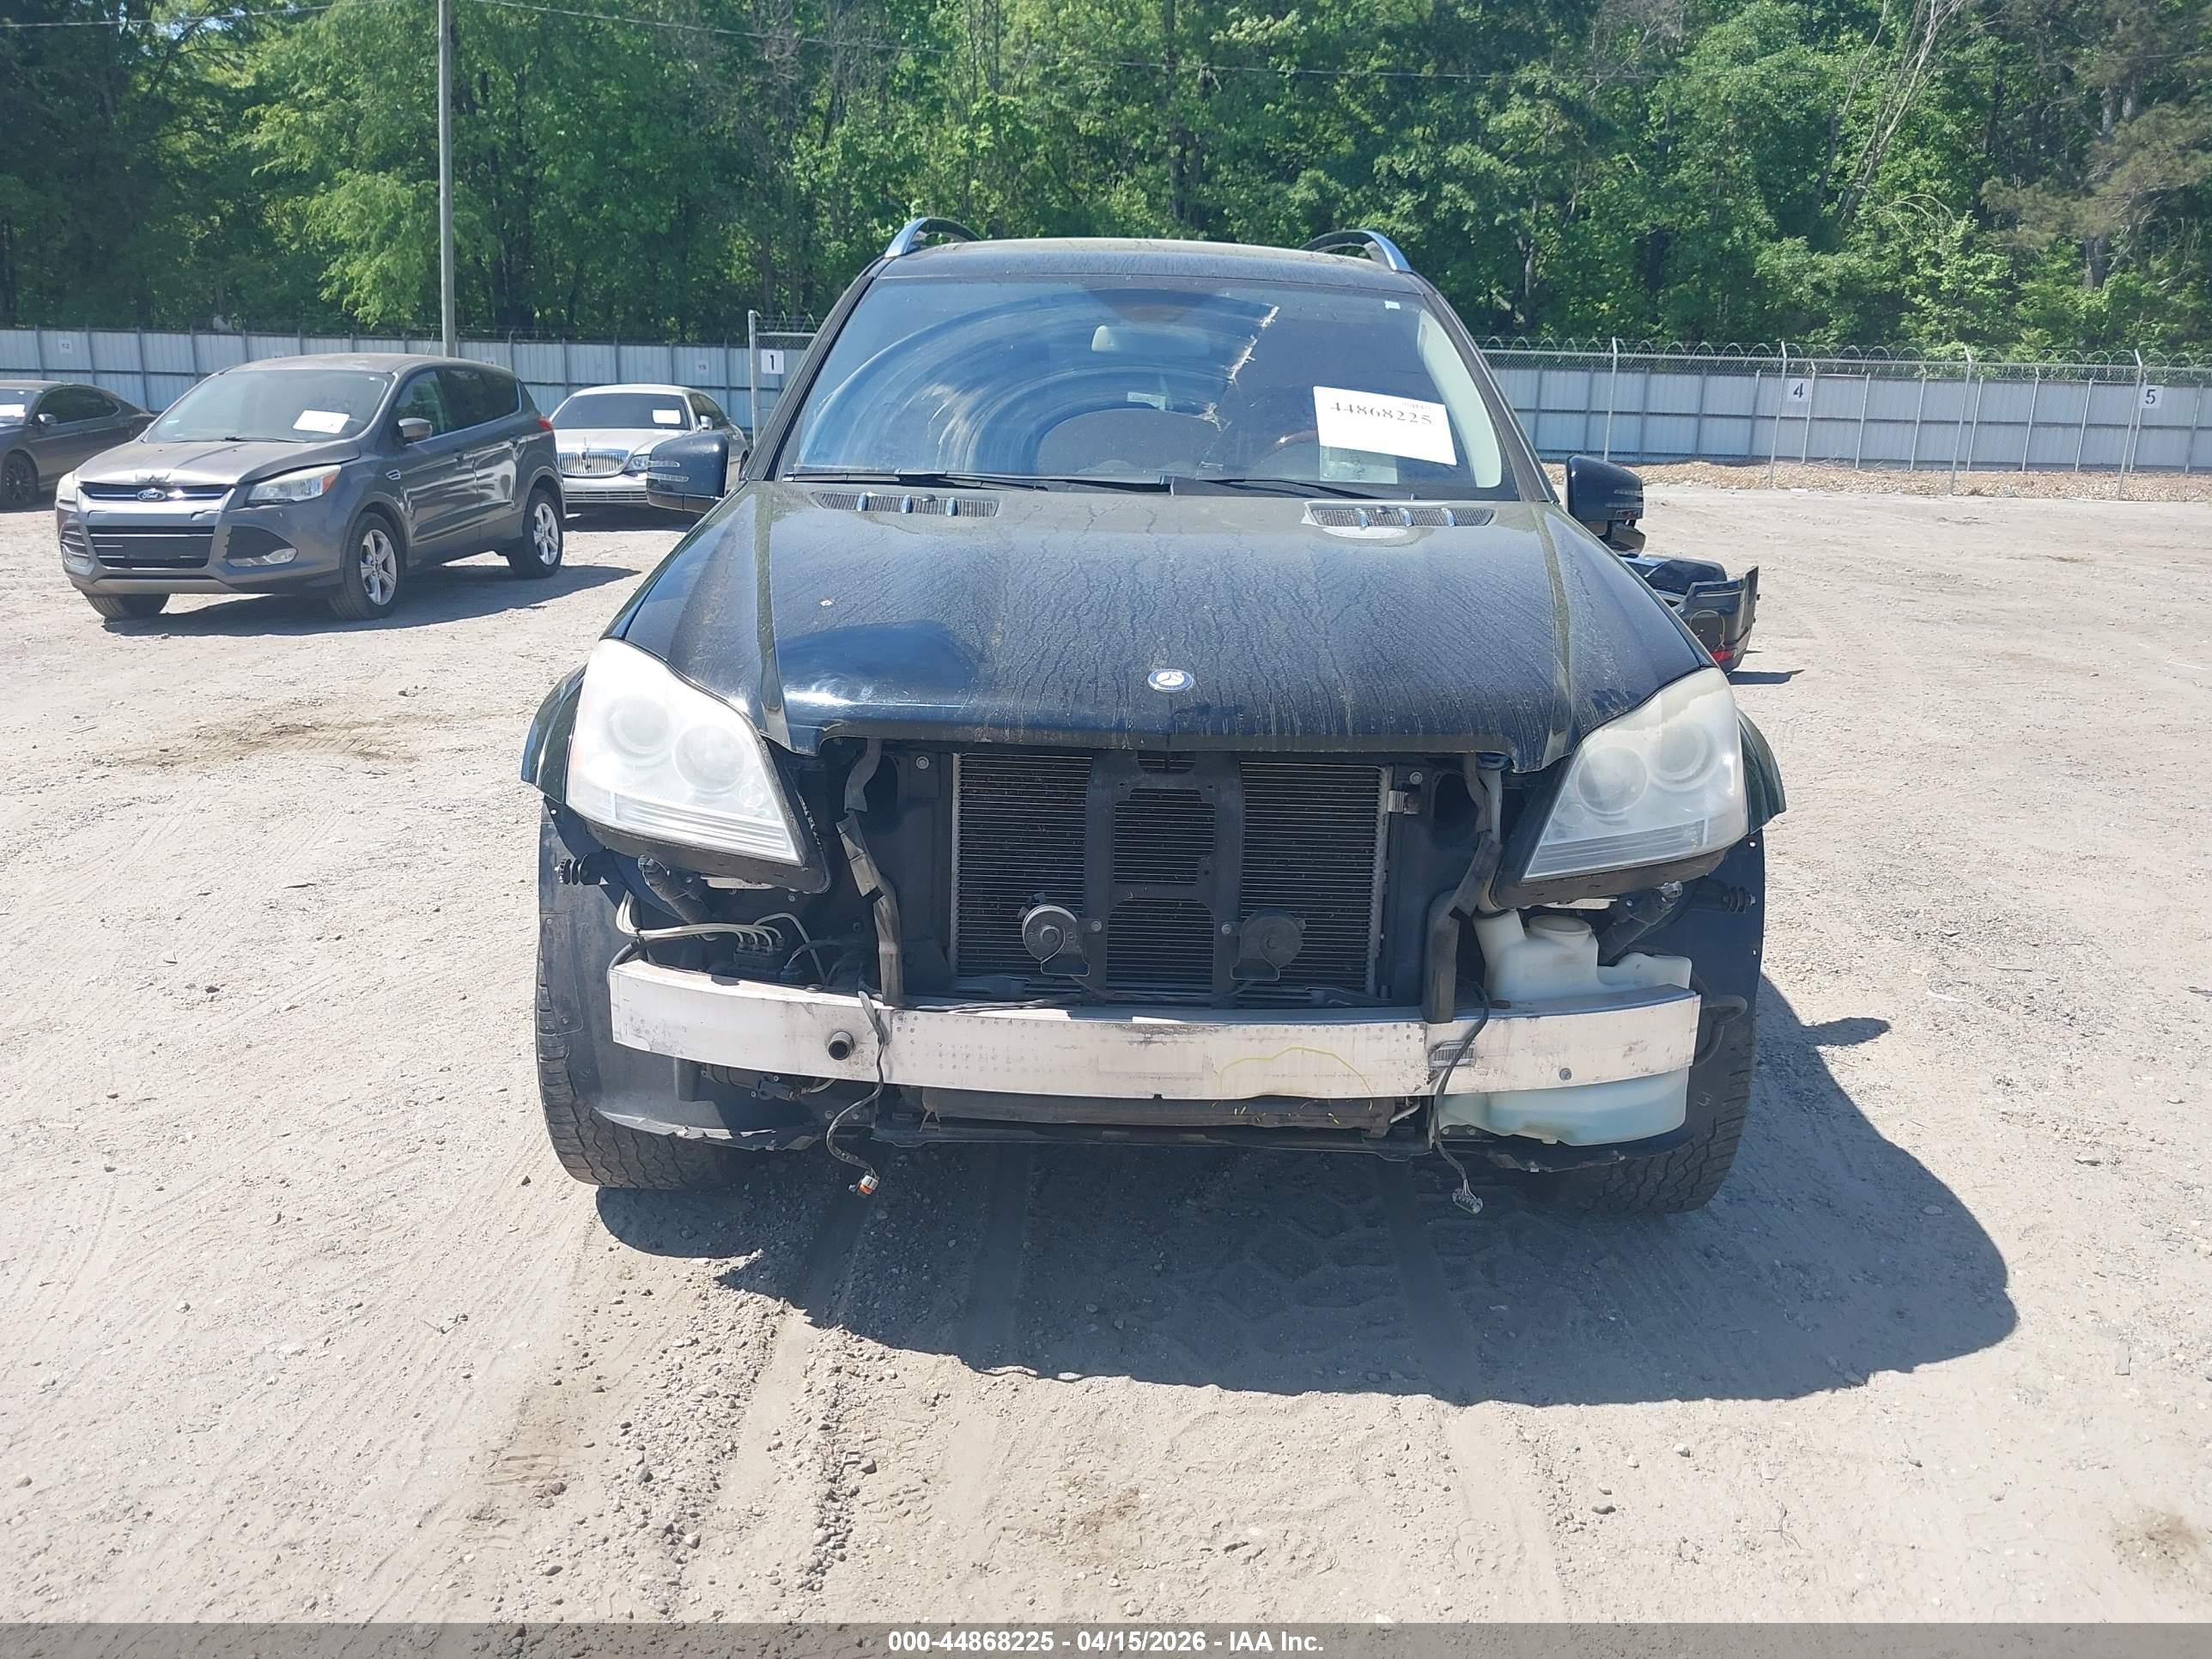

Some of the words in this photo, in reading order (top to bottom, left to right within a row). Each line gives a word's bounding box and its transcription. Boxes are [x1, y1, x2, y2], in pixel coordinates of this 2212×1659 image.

[769, 354, 775, 371] 1
[1793, 382, 1804, 398] 4
[2145, 388, 2156, 404] 5
